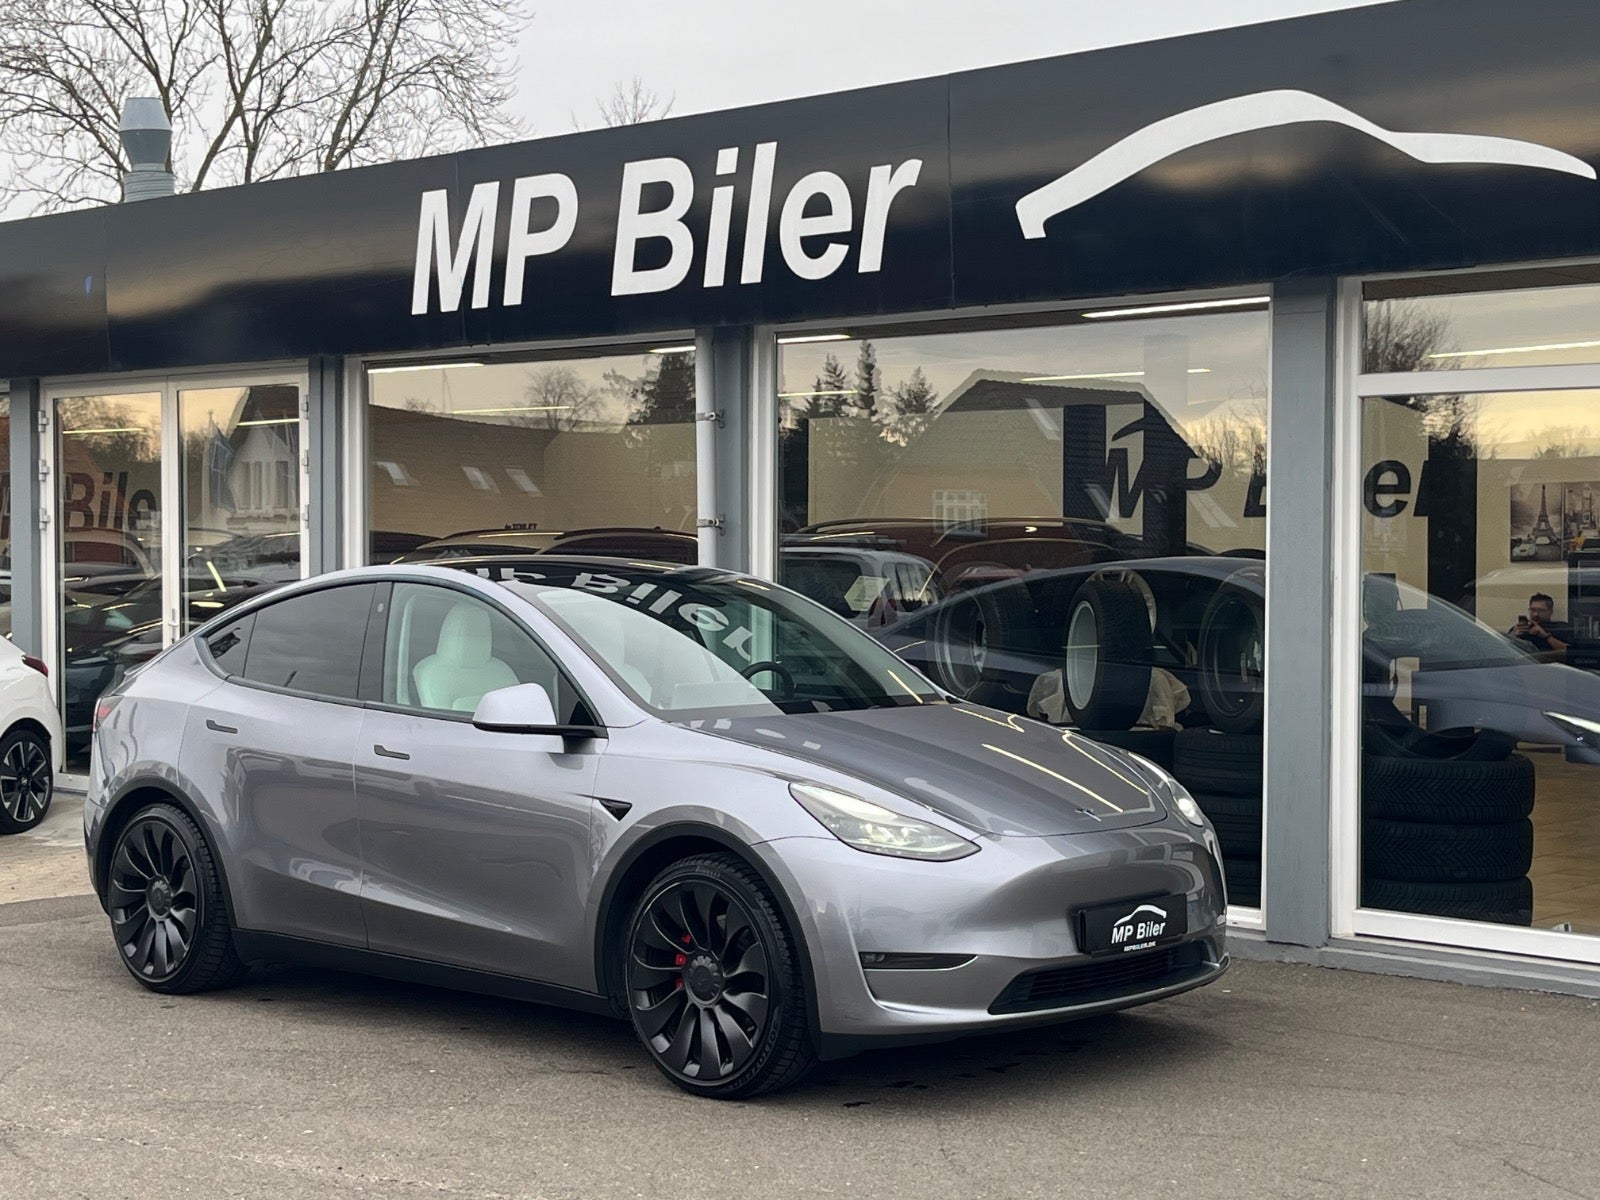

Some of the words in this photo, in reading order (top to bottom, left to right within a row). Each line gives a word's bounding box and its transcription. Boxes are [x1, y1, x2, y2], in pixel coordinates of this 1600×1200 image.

[411, 173, 579, 315] MP
[611, 142, 922, 296] Biler
[1111, 925, 1134, 944] MP
[1137, 922, 1165, 939] Biler
